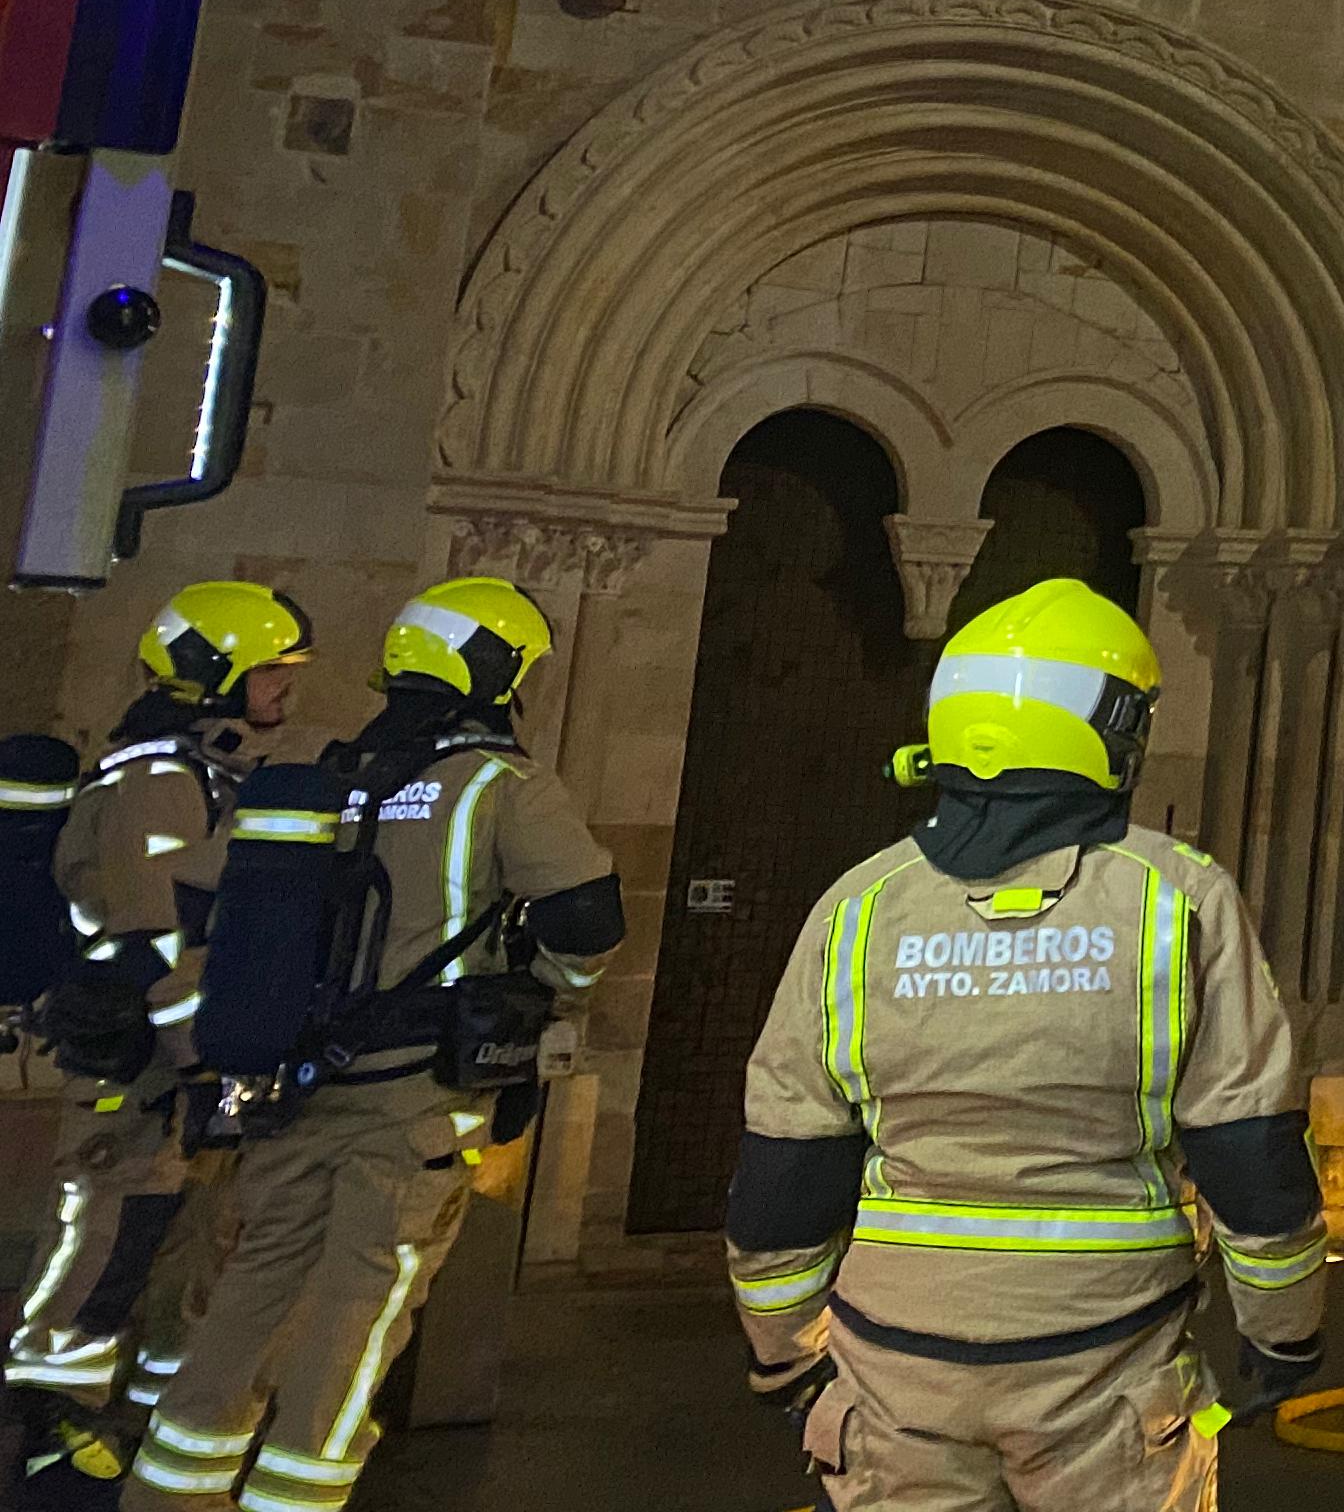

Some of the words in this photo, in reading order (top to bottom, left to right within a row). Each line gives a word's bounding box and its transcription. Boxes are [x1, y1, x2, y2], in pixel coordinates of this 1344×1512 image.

[895, 925, 1115, 969] BOMBEROS
[893, 971, 980, 999] AYTO.
[987, 966, 1112, 996] ZAMORA
